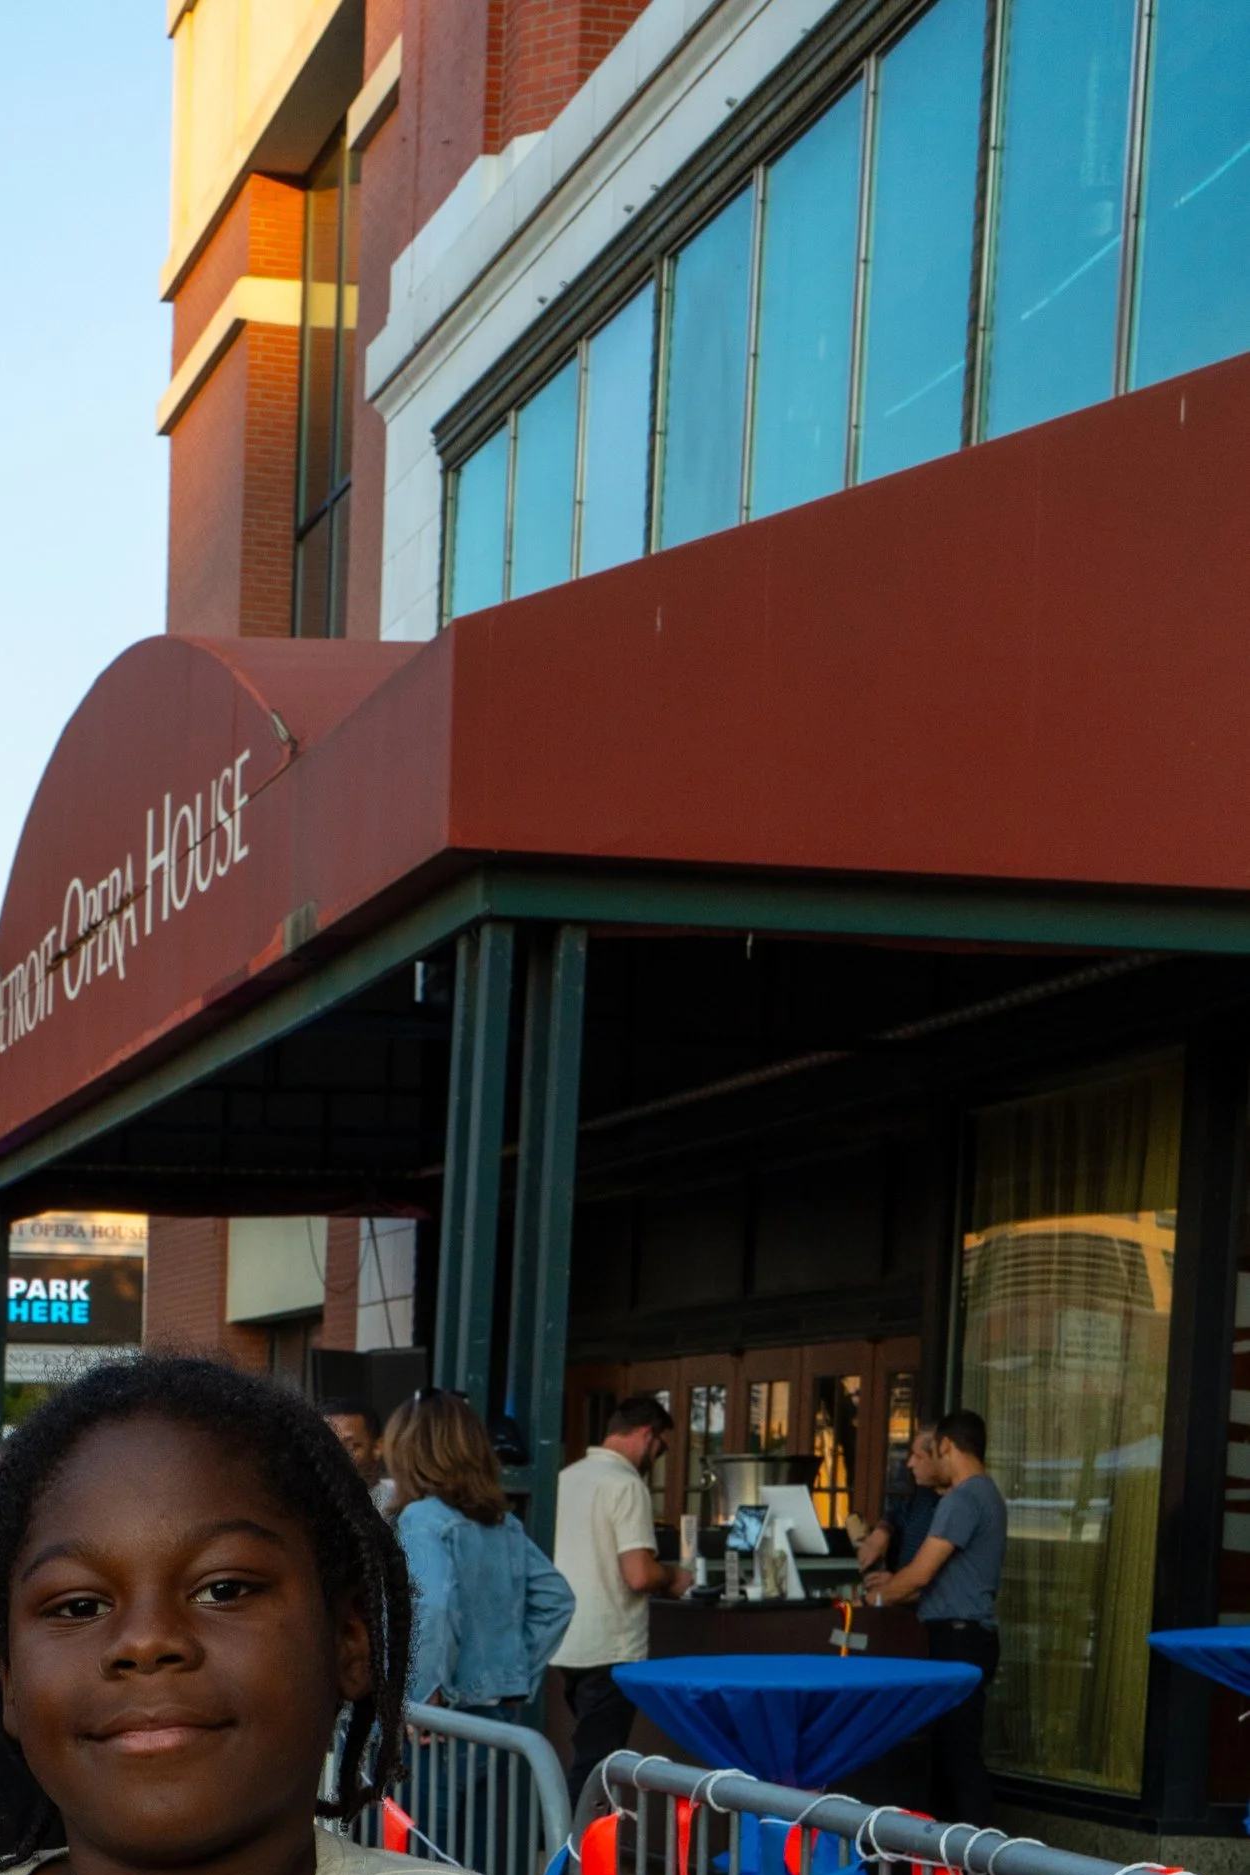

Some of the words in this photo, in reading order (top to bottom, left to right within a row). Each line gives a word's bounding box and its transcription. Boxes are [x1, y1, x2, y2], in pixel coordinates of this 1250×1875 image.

[60, 853, 137, 1000] OPERA
[145, 748, 250, 935] HOUSE
[30, 1222, 86, 1238] OPERA
[91, 1223, 149, 1240] HOUSE
[7, 1277, 91, 1301] PARK
[7, 1301, 91, 1324] HERE
